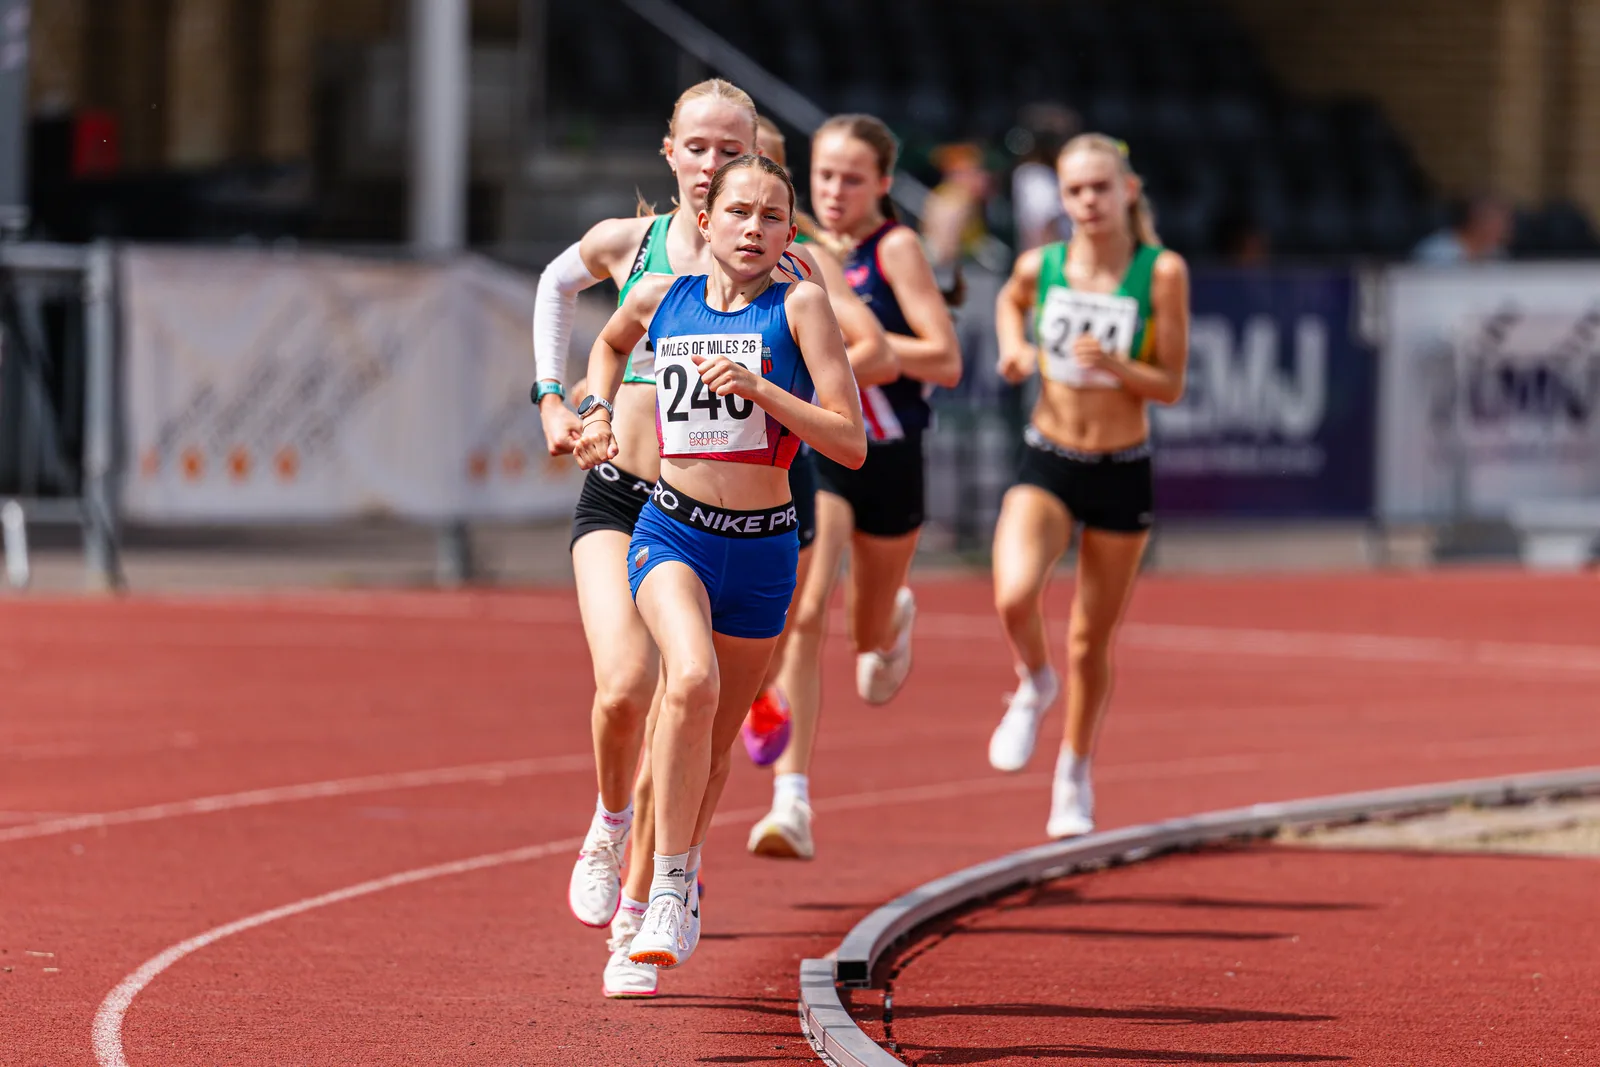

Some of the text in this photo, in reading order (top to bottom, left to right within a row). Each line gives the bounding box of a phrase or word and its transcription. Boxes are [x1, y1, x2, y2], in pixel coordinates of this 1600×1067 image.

[660, 341, 689, 357] MILES
[691, 340, 705, 355] OF
[707, 339, 739, 355] MILES
[741, 339, 756, 354] 26
[688, 430, 729, 440] comms
[689, 438, 729, 447] express
[690, 506, 764, 533] NIKE
